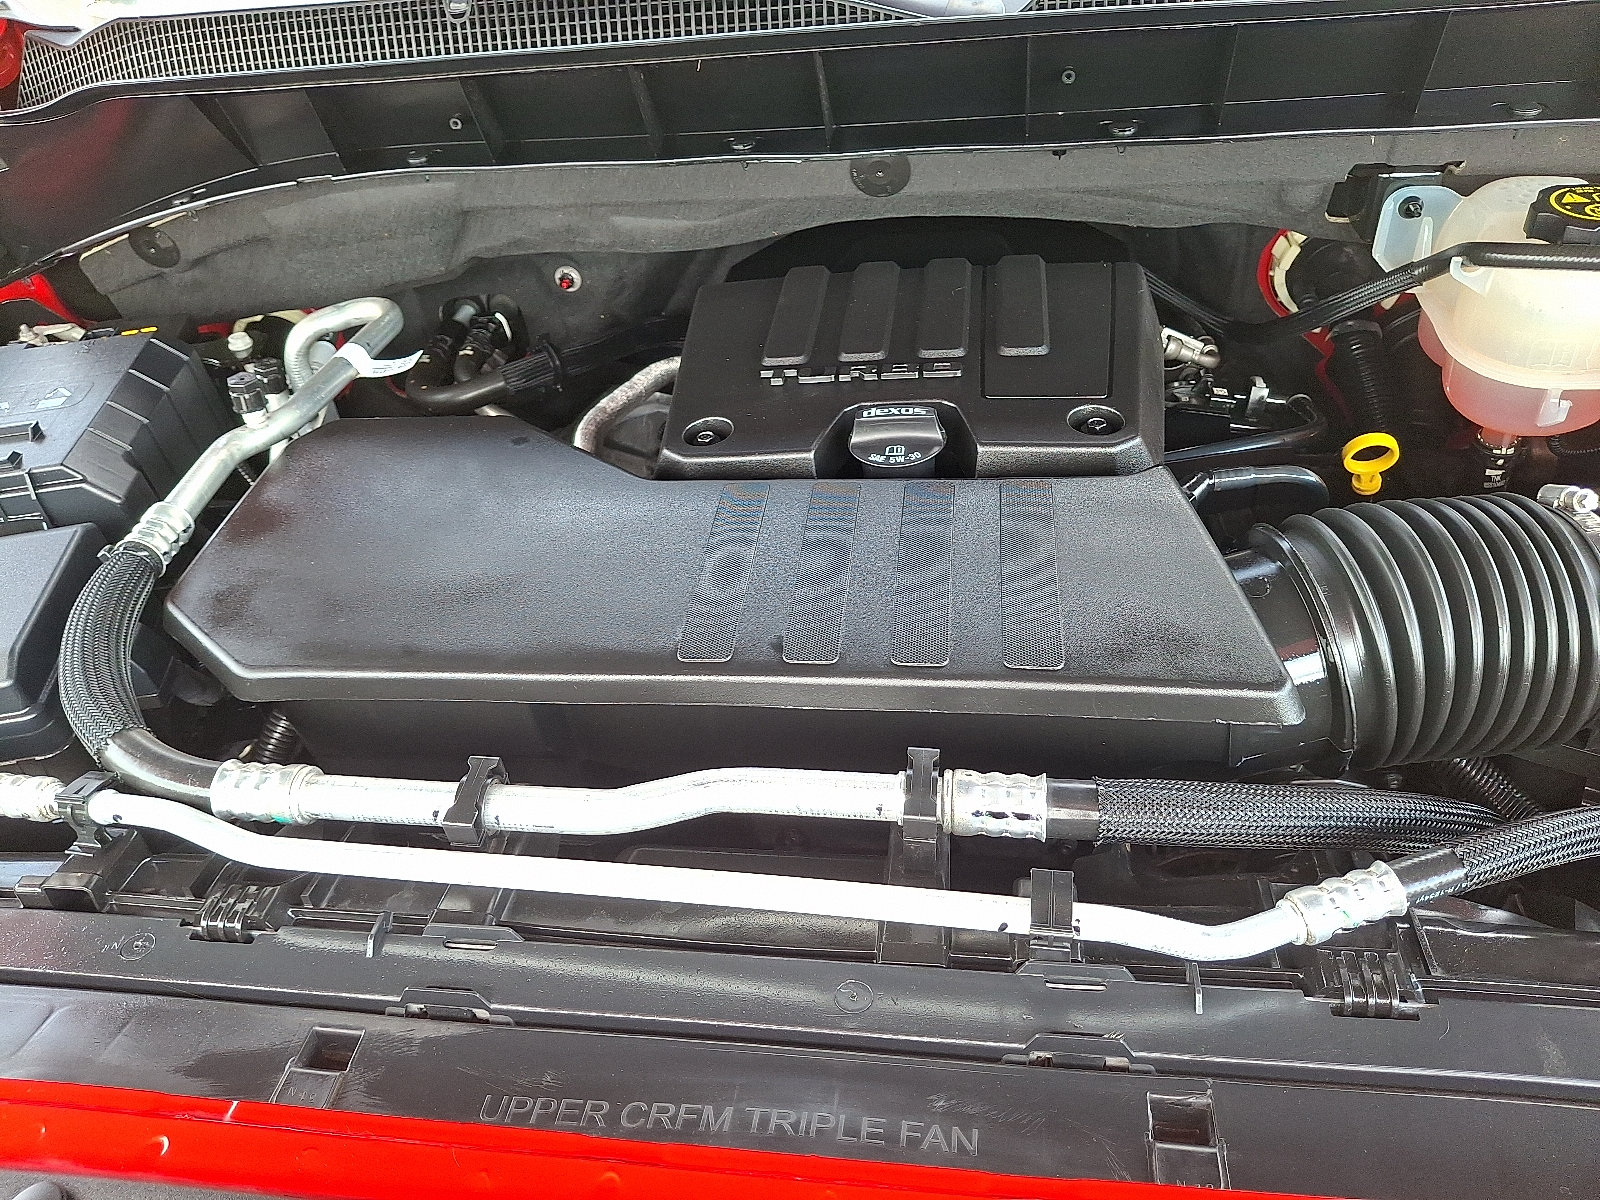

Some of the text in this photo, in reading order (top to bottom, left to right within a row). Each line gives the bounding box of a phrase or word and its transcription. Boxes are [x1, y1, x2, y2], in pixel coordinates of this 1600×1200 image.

[862, 407, 928, 417] dexos
[868, 451, 922, 464] SAE 5W-30
[479, 1094, 979, 1157] UPPER CRFM TRIPLE FAN
